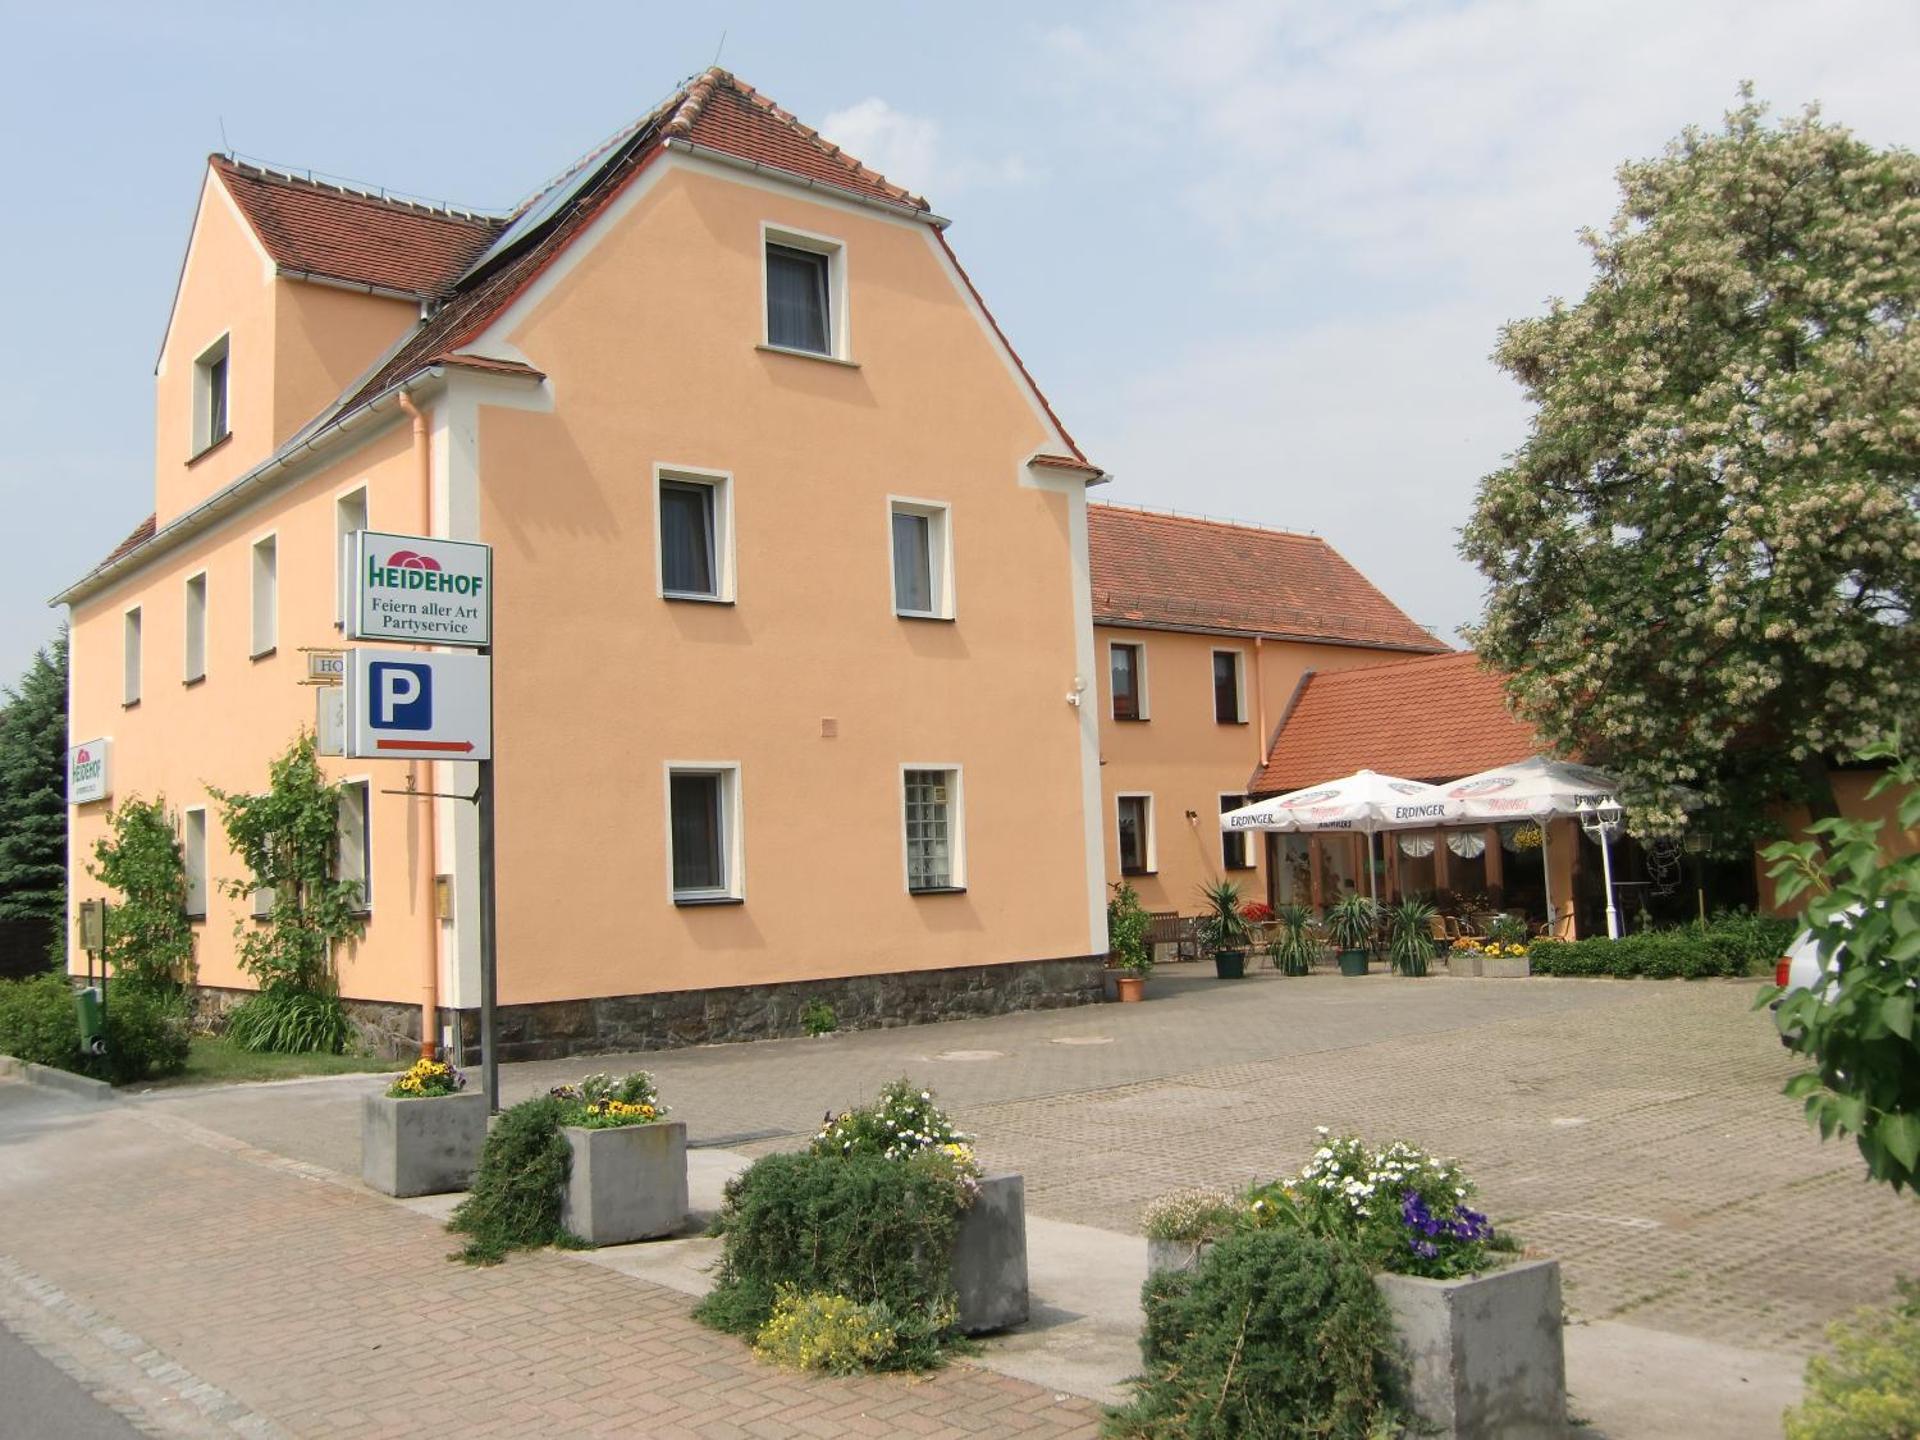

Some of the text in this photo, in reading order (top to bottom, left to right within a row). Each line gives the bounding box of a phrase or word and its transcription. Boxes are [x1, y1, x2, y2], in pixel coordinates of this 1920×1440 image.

[369, 554, 483, 597] HEIDEHOF
[372, 597, 478, 619] Feiern aller Art
[382, 615, 468, 634] Partyservice
[381, 668, 421, 723] P
[1230, 813, 1275, 827] ERDINGER
[1395, 804, 1445, 819] ERDINGER
